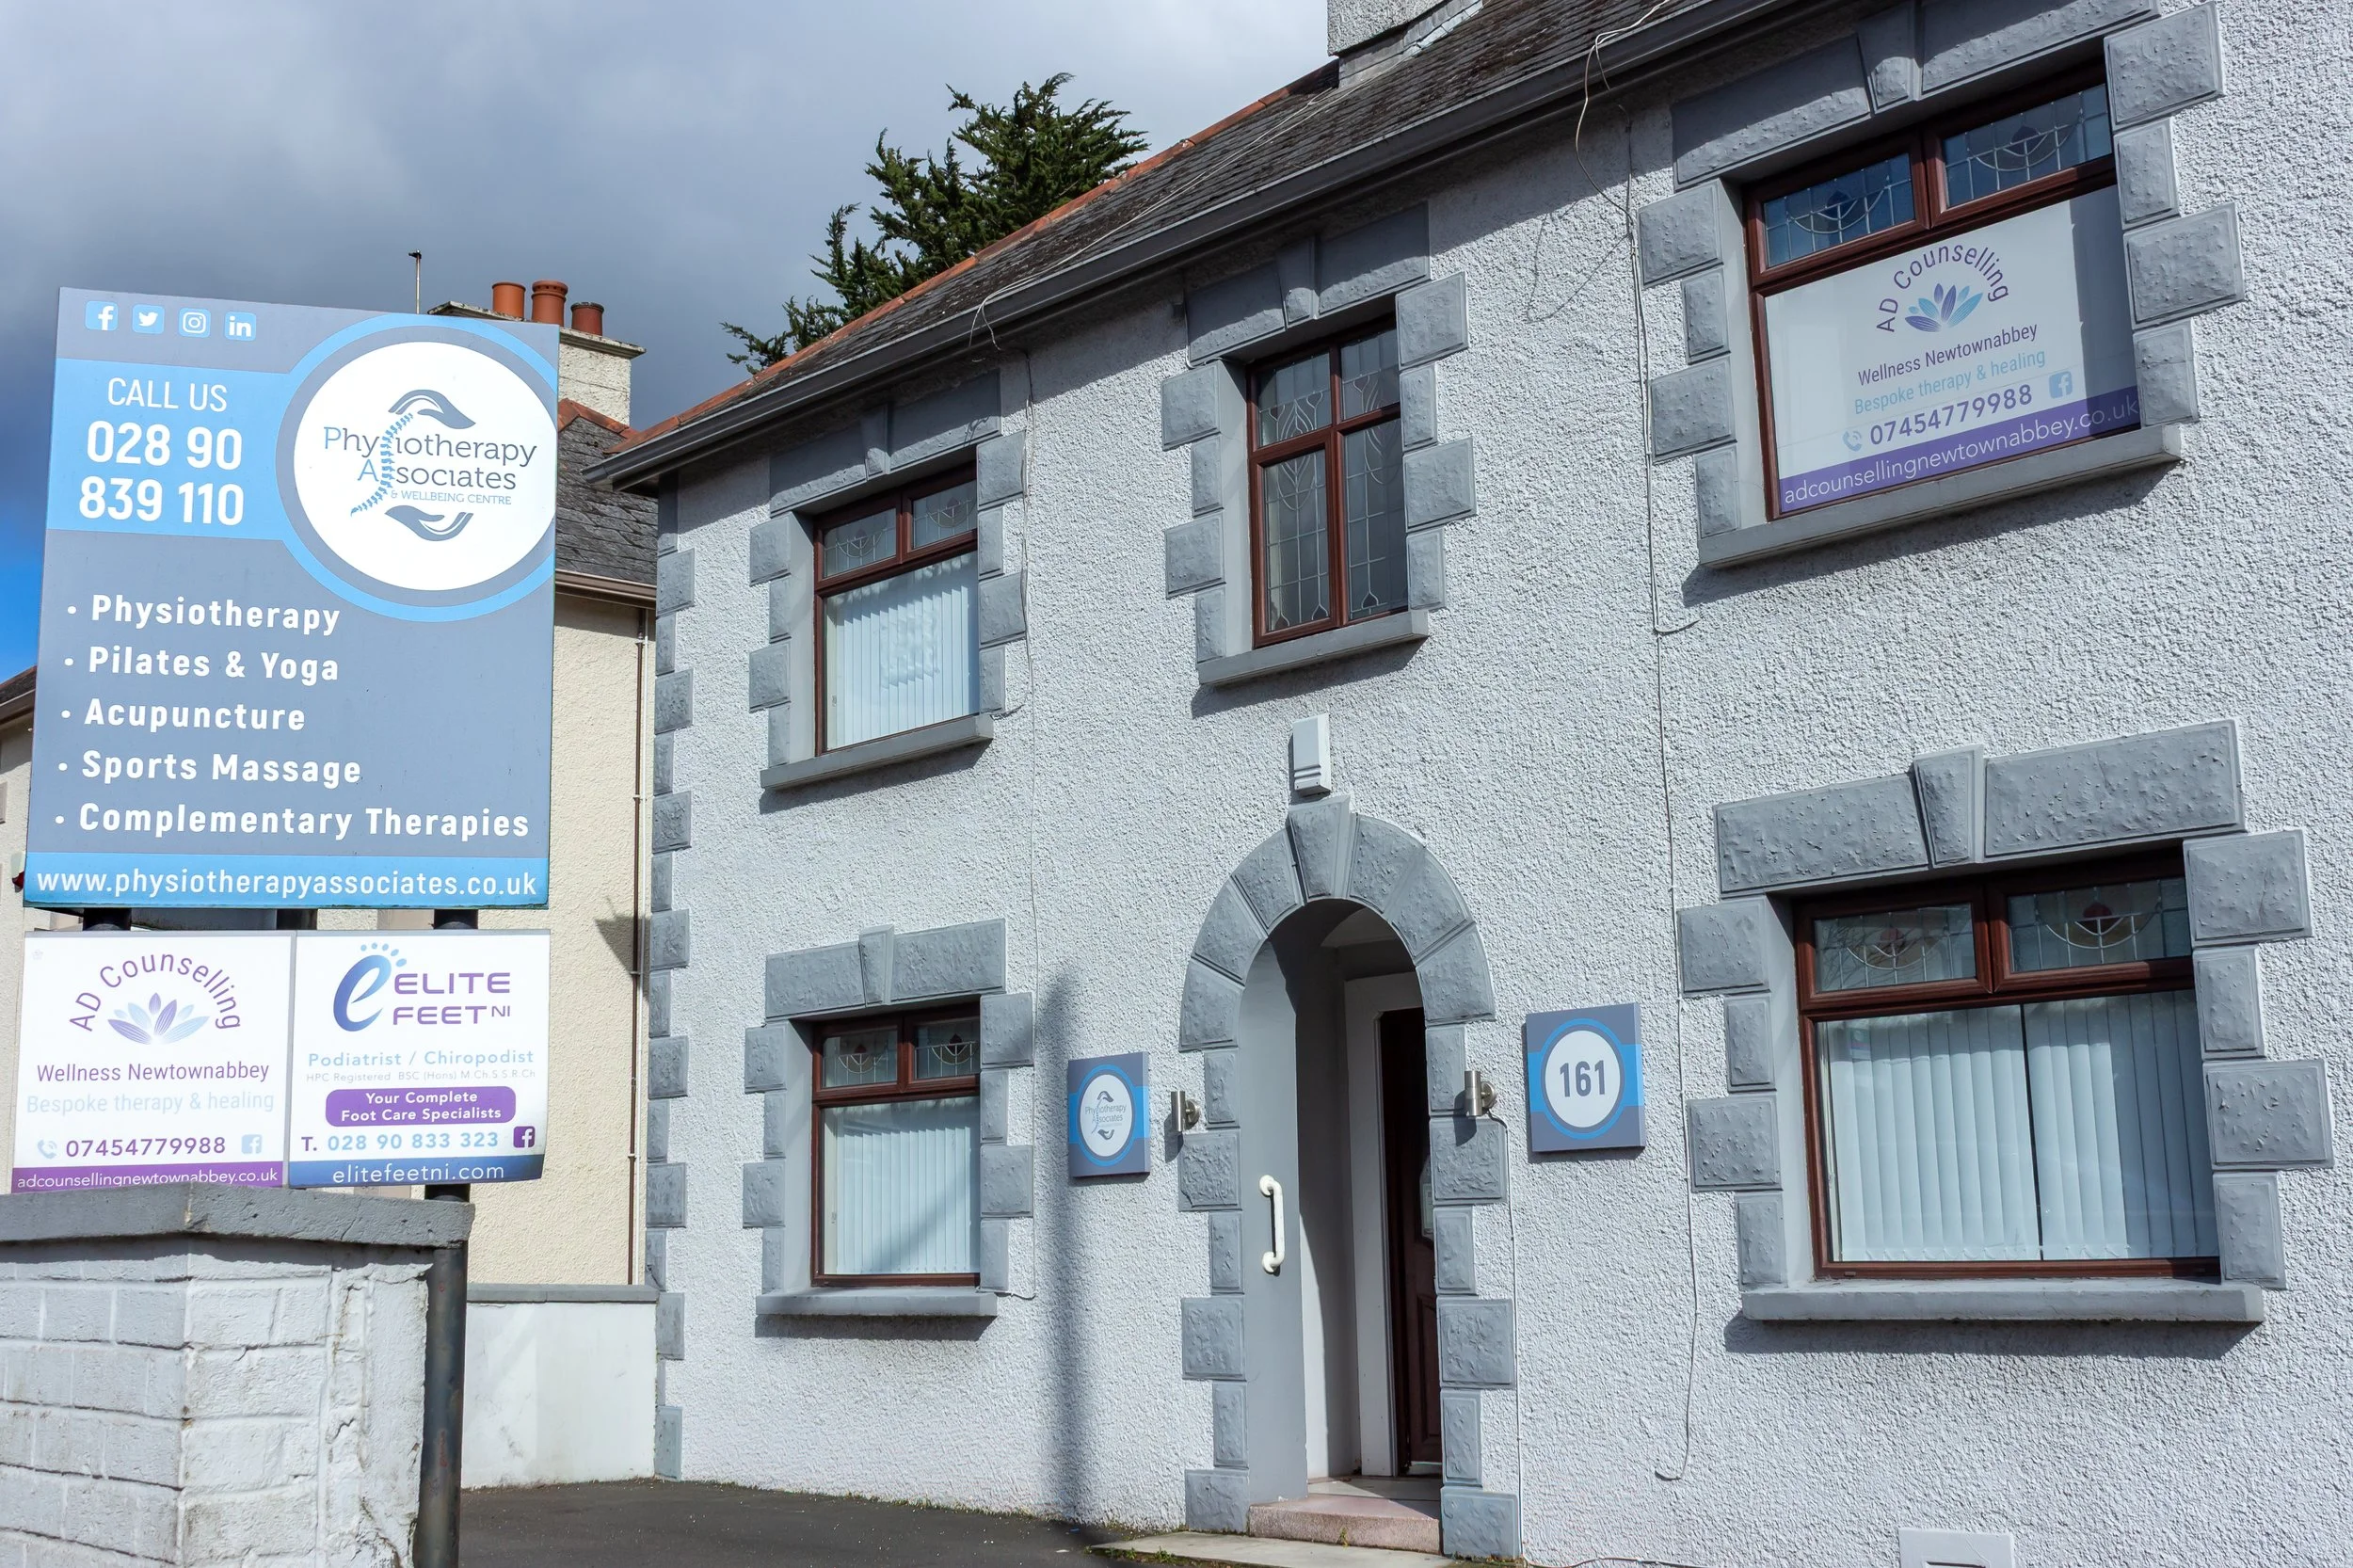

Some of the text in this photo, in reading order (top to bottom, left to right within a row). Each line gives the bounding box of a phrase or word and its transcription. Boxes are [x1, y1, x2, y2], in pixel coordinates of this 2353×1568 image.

[1876, 244, 2009, 333] AD Counselling
[1858, 324, 2038, 386] Wellness Newtownabbey
[107, 377, 228, 412] CALL US
[1854, 351, 2046, 415] Bespoke therapy & healing
[1870, 384, 2032, 445] 07454779988
[87, 421, 242, 470] 028 90
[1785, 395, 2139, 504] adcounsellingnewtownabbey.co.uk
[78, 476, 244, 525] 839 110
[400, 490, 465, 503] WELLBEING
[467, 494, 511, 504] CENTRE
[91, 594, 341, 635] Physiotherapy
[88, 646, 339, 686] Pilates & Yoga
[84, 697, 305, 732] Acupuncture
[82, 750, 361, 789] Sports Massage
[79, 803, 529, 841] Complementary Therapies
[37, 868, 536, 898] www.physiotherapyassociates.co.uk
[69, 952, 241, 1032] AD Counselling
[394, 972, 510, 995] ELITE
[392, 1005, 510, 1026] FEET NI
[38, 1061, 269, 1082] Wellness Newtownabbey
[309, 1051, 402, 1067] Podiatrist
[424, 1049, 535, 1067] Chiropodist
[306, 1073, 329, 1082] HPC
[333, 1072, 391, 1084] Registered
[398, 1071, 420, 1080] BSC
[1560, 1060, 1606, 1097] 161
[26, 1091, 275, 1116] Bespoke therapy & healing
[341, 1107, 501, 1122] Foot Care Specialists
[365, 1092, 478, 1105] Your Complete
[66, 1137, 226, 1158] 07454779988
[301, 1137, 318, 1152] T.
[328, 1135, 367, 1151] 028
[376, 1134, 403, 1150] 90
[411, 1133, 450, 1148] 833
[459, 1131, 499, 1148] 323
[333, 1163, 504, 1184] elitefeetni.com
